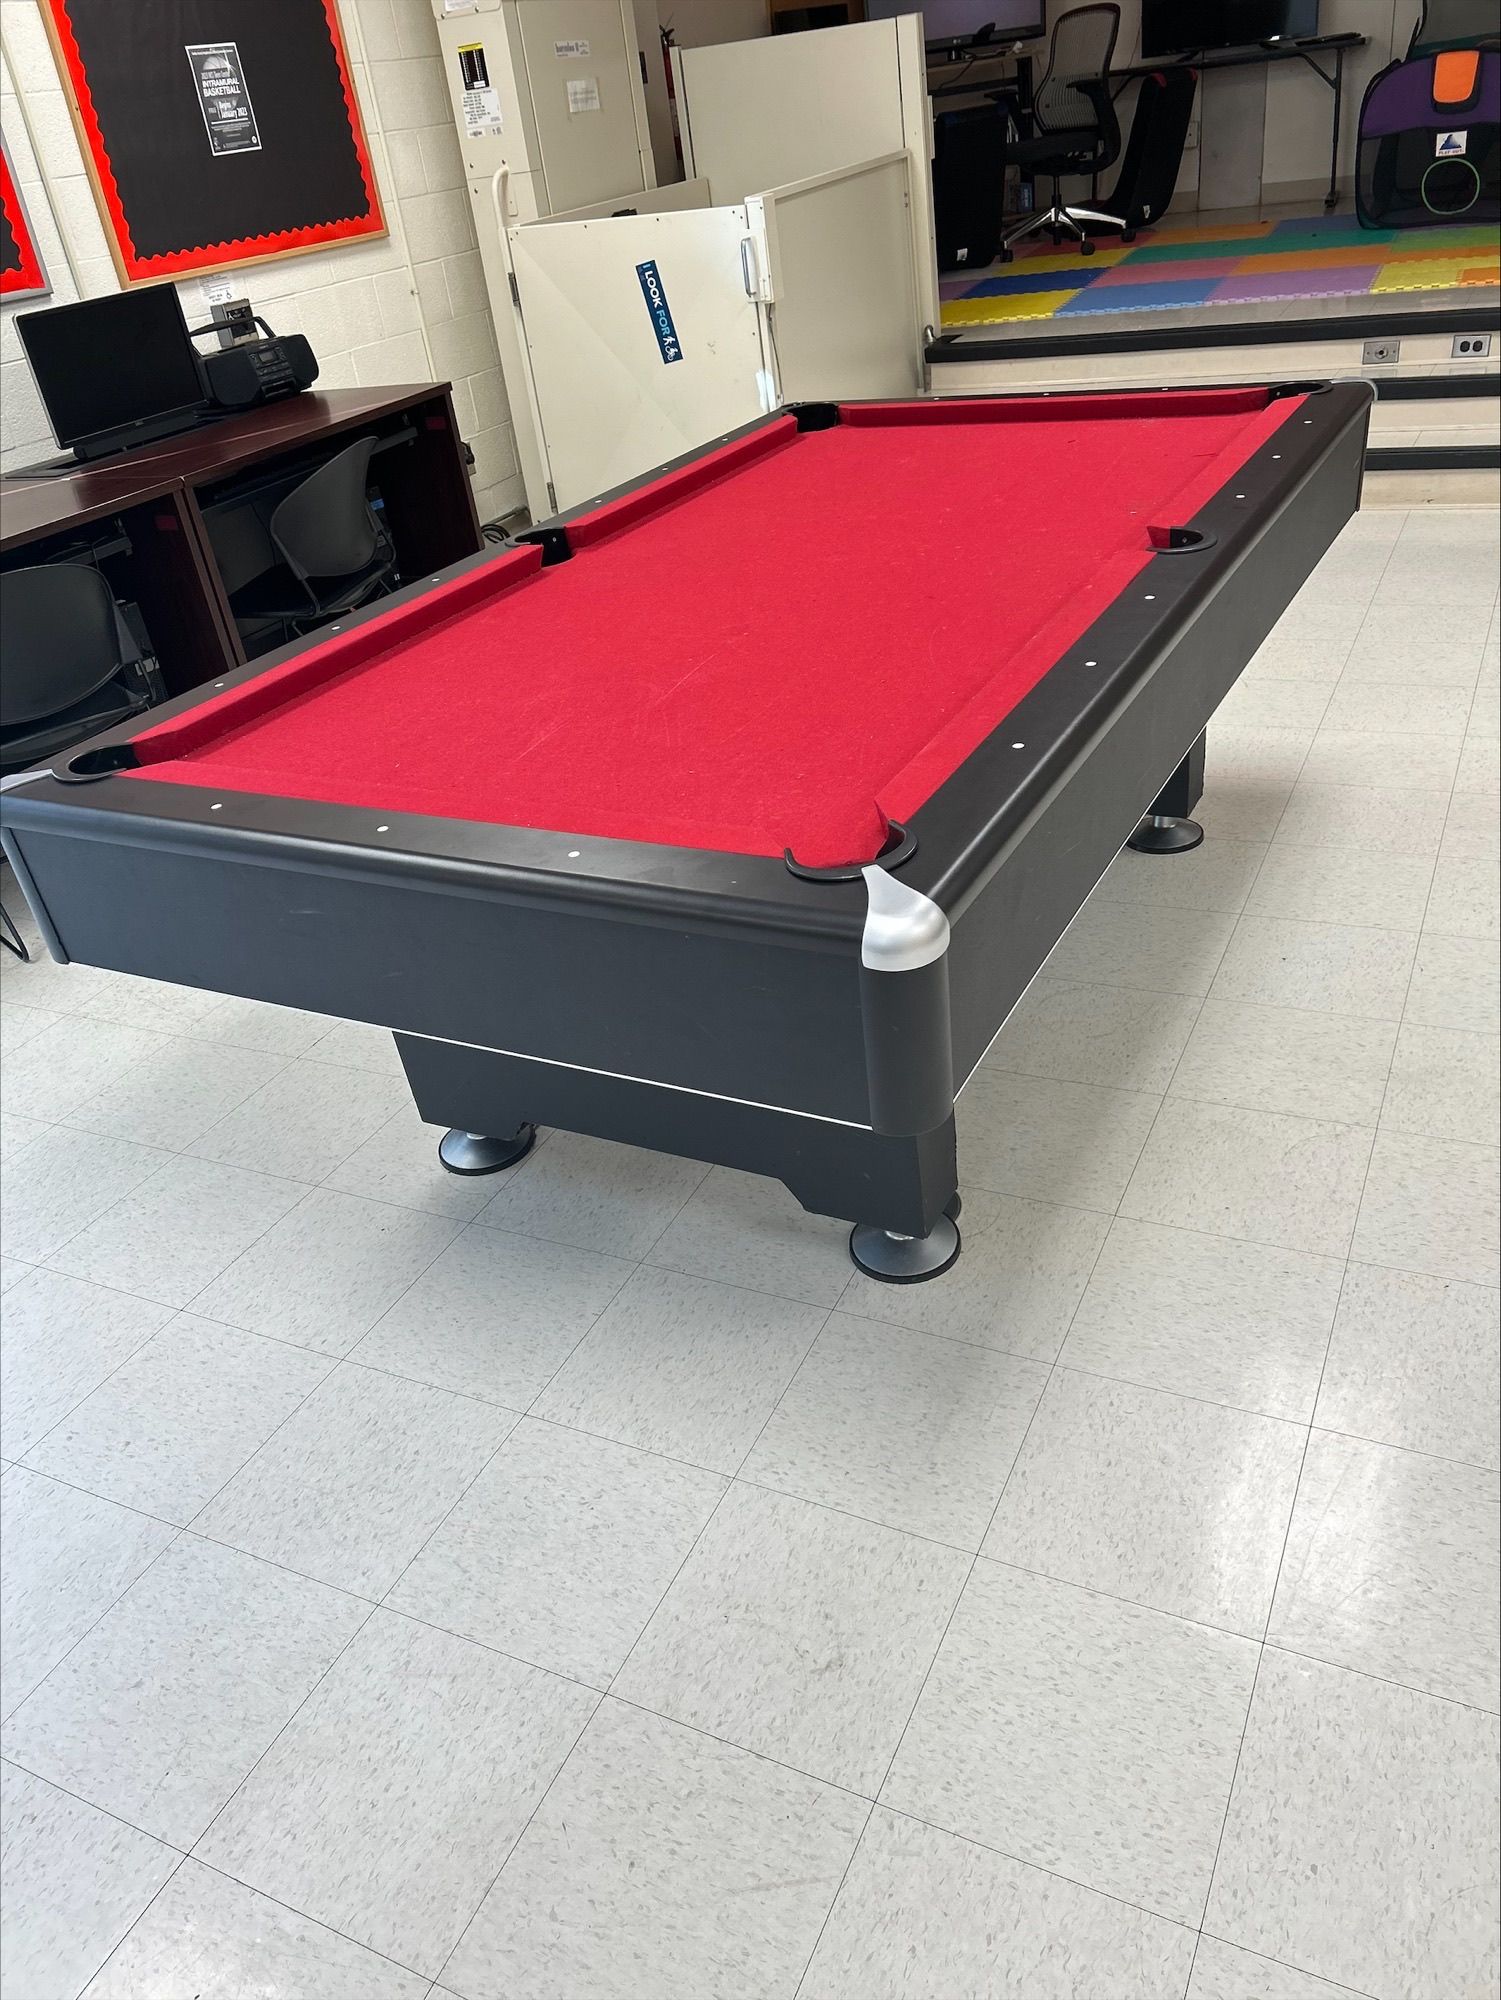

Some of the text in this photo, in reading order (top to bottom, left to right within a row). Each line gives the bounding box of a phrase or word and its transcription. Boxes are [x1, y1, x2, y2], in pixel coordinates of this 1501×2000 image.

[202, 78, 239, 87] INTRAMURAL
[203, 85, 241, 97] BASKETBALL
[644, 270, 663, 308] LOOK
[656, 309, 671, 336] FOR
